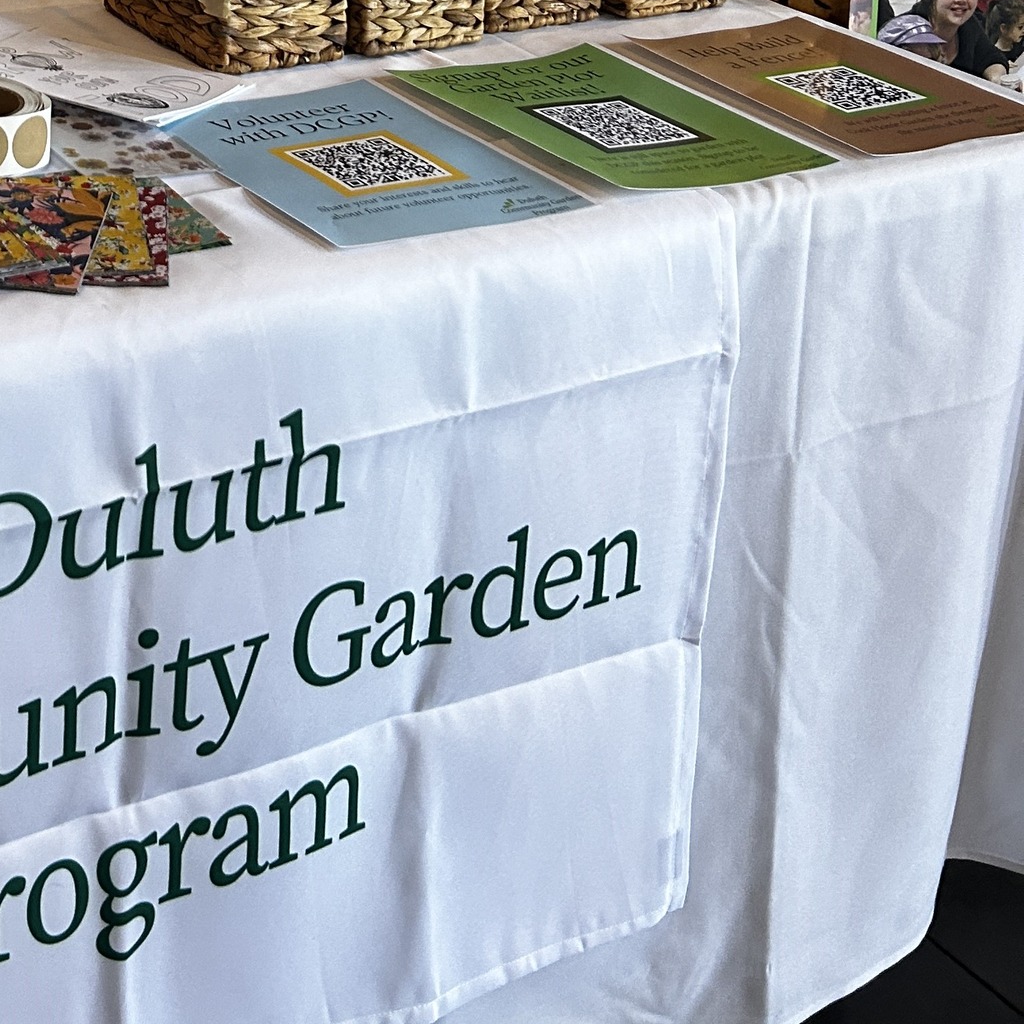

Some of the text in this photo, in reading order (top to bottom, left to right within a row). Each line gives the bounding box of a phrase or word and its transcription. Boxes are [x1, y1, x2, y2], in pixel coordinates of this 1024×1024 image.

[677, 34, 805, 58] Help Build
[727, 47, 824, 70] a Fence!
[409, 53, 592, 85] Signup for our
[448, 69, 604, 94] Garden Plot
[489, 83, 606, 104] Waitlist!
[207, 103, 350, 131] Volunteer
[219, 110, 394, 146] with DCGP!
[317, 175, 520, 213] Share your interests and skills to hear
[331, 209, 364, 221] about
[366, 203, 400, 215] future
[403, 193, 455, 209] volunteer
[292, 525, 642, 687] Garden
